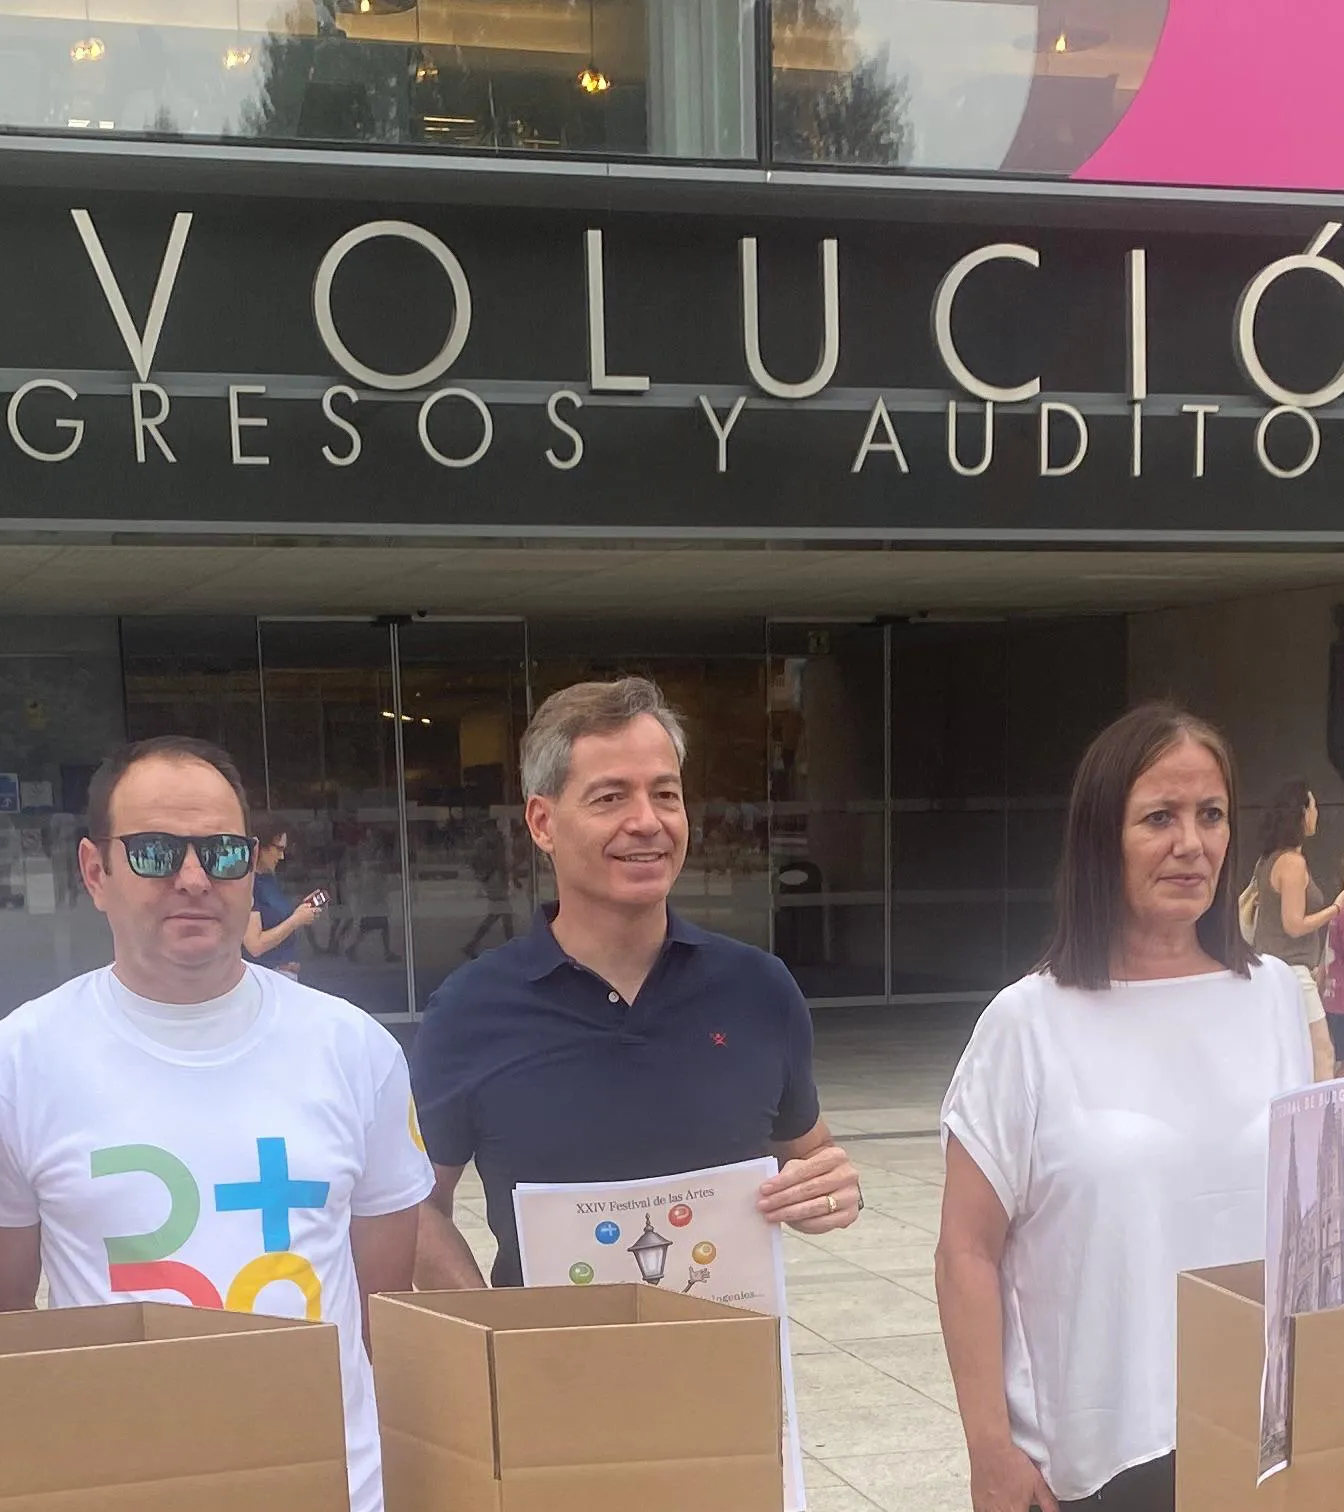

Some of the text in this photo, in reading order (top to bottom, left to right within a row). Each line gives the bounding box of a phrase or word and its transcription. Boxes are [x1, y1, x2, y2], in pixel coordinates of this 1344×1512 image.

[698, 395, 748, 475] Y
[576, 1187, 715, 1215] XXIV Festival de las Artes
